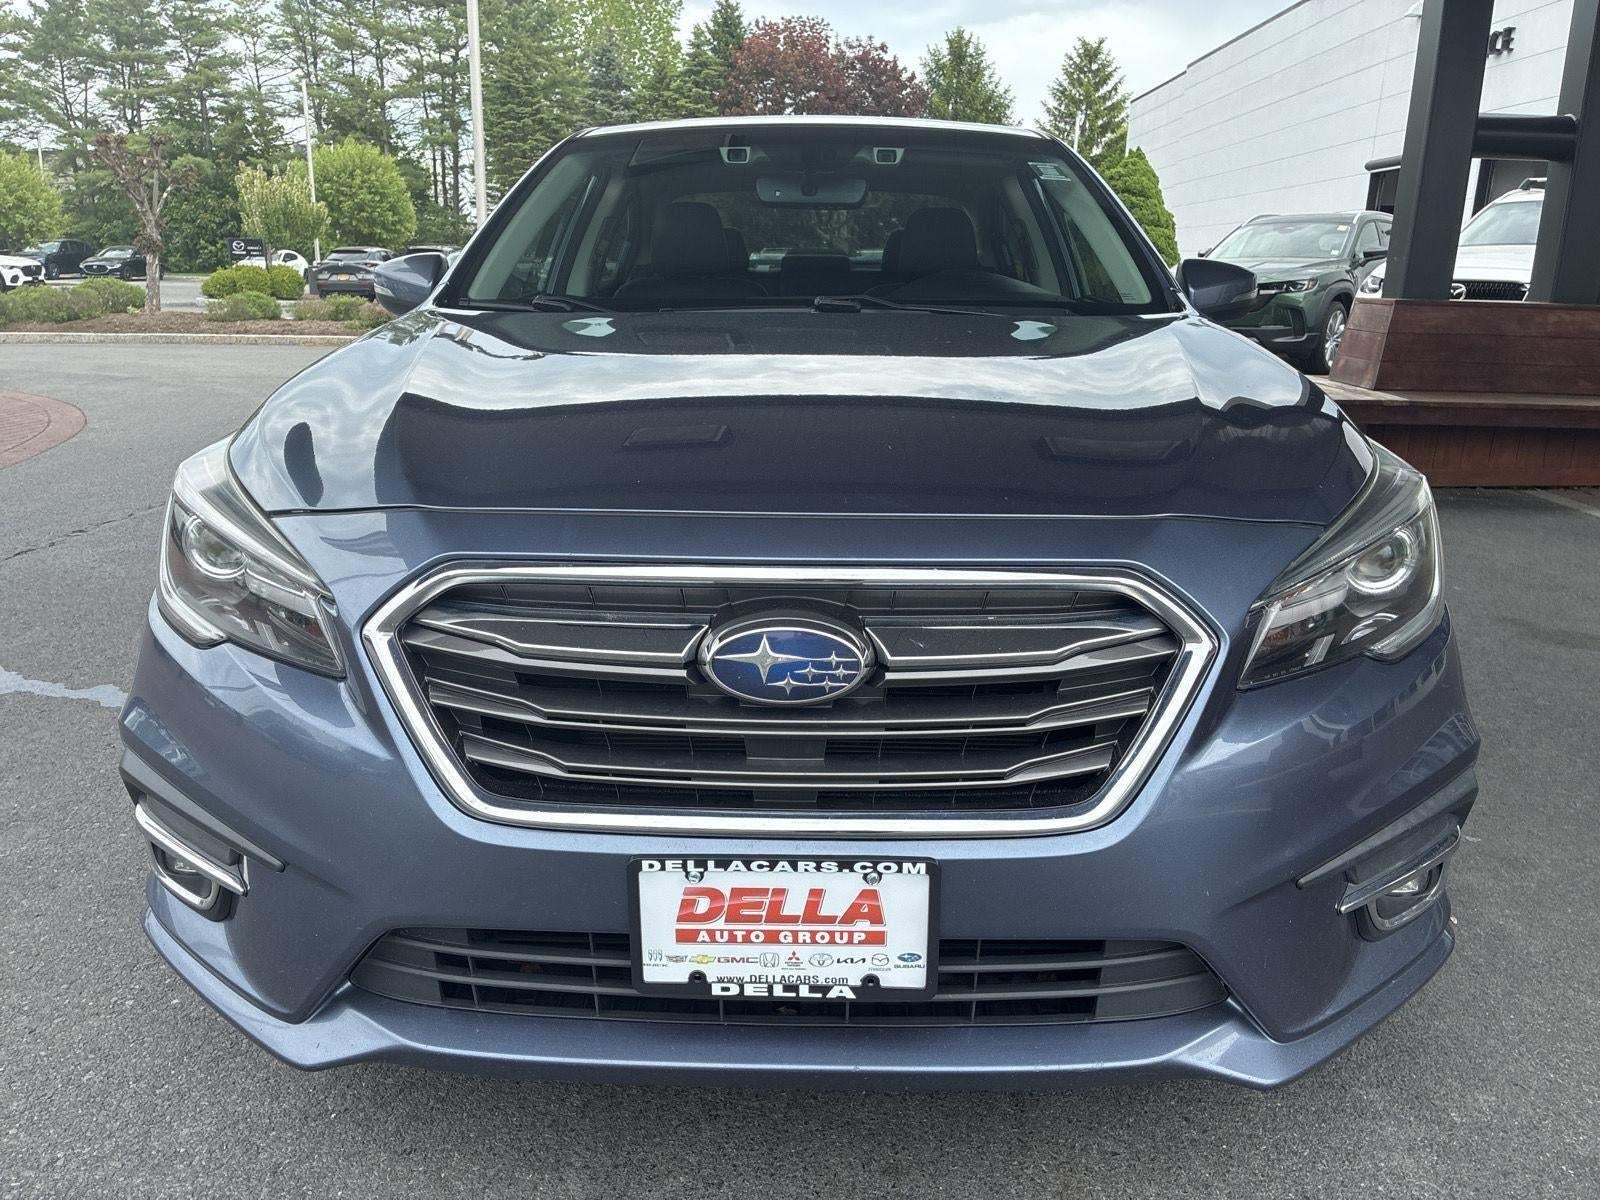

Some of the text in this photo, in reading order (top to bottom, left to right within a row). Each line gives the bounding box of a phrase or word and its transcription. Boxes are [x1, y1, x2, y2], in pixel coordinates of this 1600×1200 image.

[641, 860, 926, 874] DELLACARS.COM
[676, 887, 886, 926] DELLA
[696, 930, 867, 944] AUTO GROUP
[717, 956, 759, 964] GMC
[711, 983, 857, 998] DELLA
